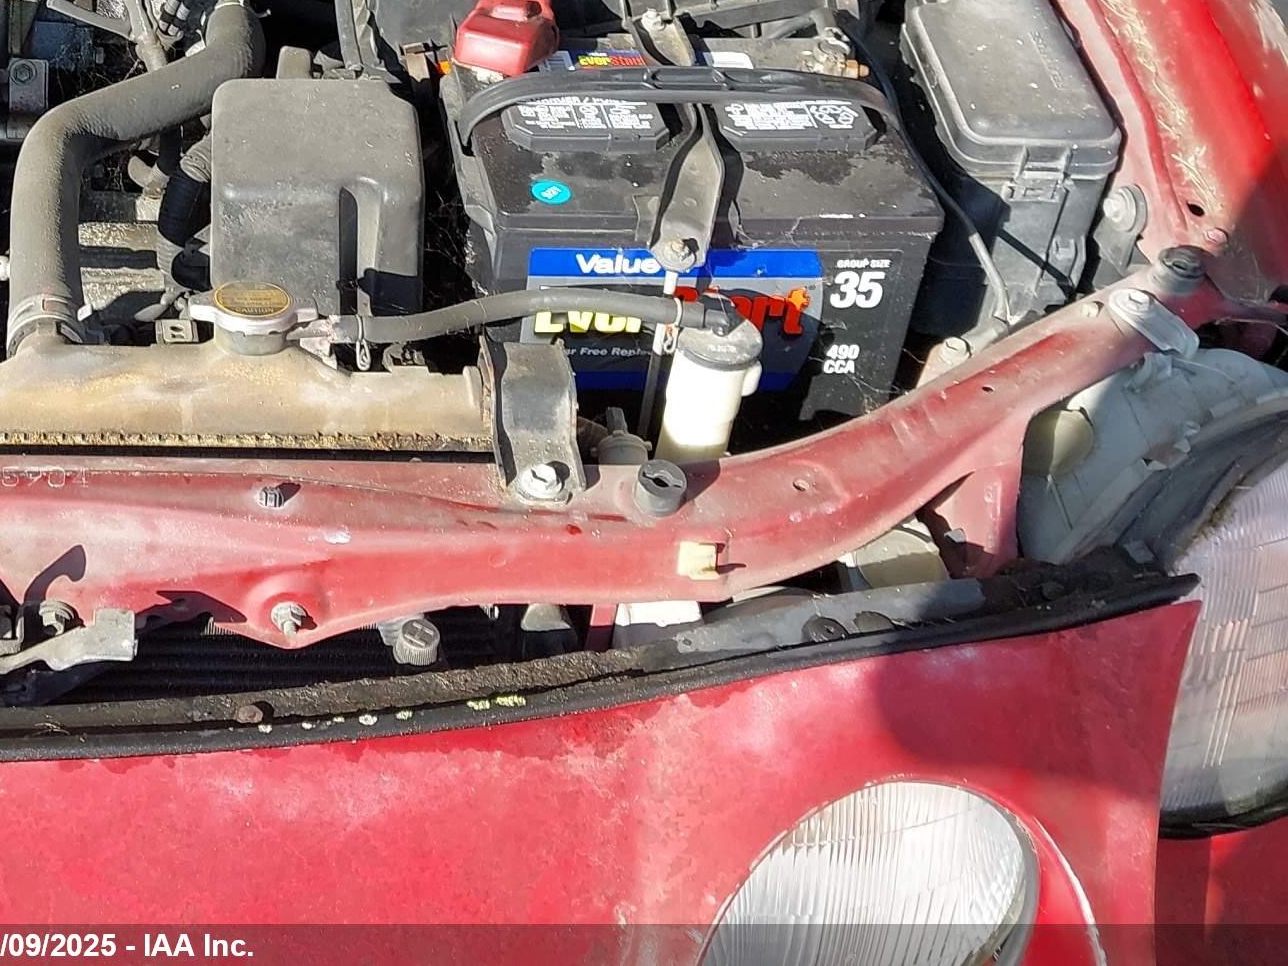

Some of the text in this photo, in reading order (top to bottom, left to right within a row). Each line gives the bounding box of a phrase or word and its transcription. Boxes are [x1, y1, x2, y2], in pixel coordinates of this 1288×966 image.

[575, 253, 661, 274] Value
[836, 259, 892, 269] GROUP SIZE
[830, 270, 886, 309] 35
[580, 347, 608, 356] Free
[826, 344, 860, 360] 490
[823, 360, 856, 374] CCA
